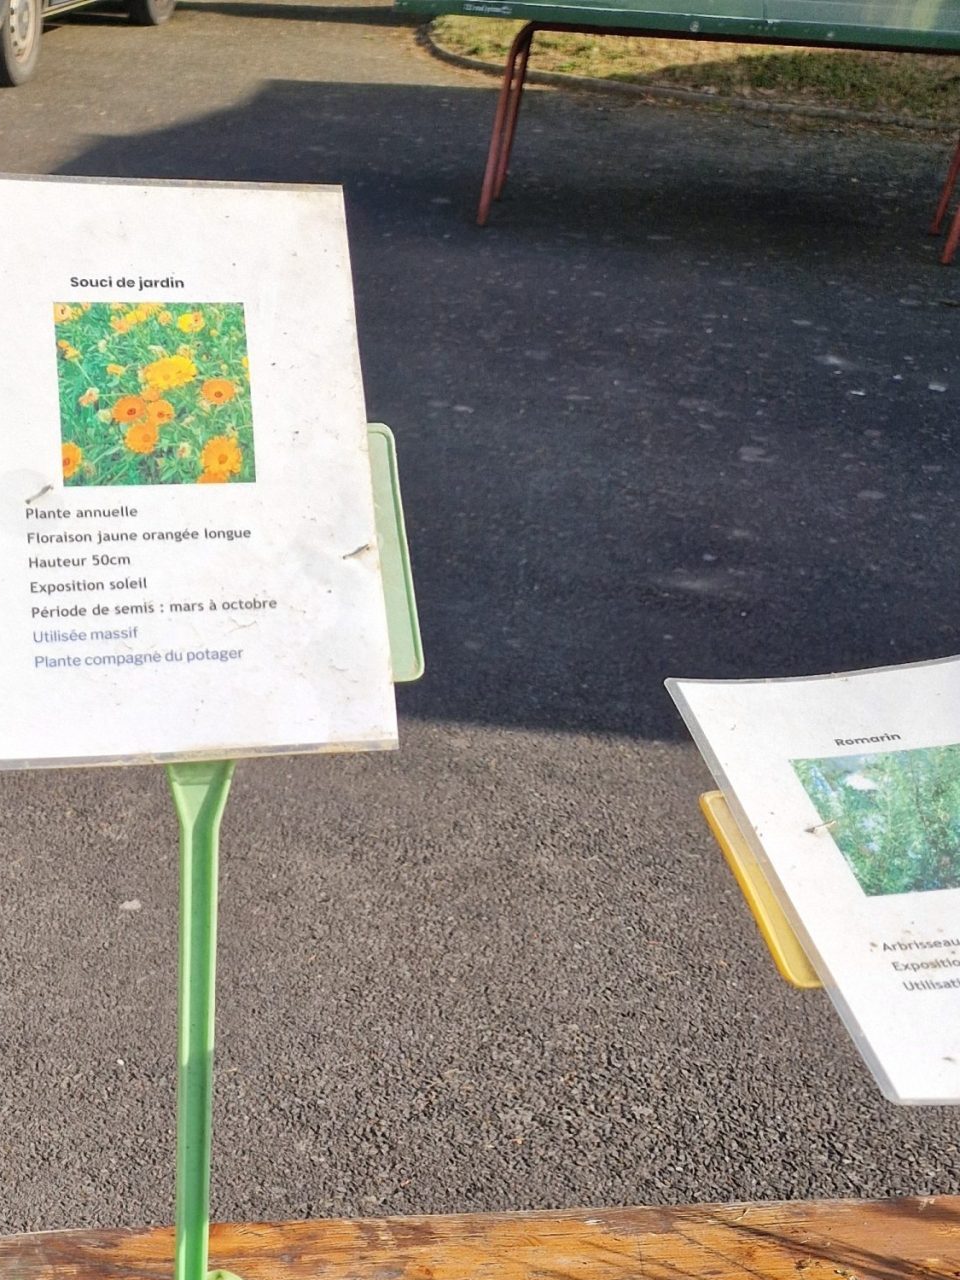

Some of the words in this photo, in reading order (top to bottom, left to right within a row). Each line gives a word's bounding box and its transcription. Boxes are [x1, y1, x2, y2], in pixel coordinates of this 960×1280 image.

[69, 276, 113, 289] Souci
[115, 277, 136, 289] de
[137, 276, 185, 292] jardin
[25, 508, 72, 520] Plante
[75, 506, 139, 519] annuelle
[26, 532, 93, 545] Floraison
[96, 530, 138, 545] jaune
[141, 528, 200, 543] orangée
[203, 528, 252, 542] longue
[28, 557, 88, 569] Hauteur
[91, 554, 131, 567] 50cm
[30, 580, 104, 595] Exposition
[108, 577, 148, 591] soleil
[30, 605, 88, 619] Période
[91, 604, 111, 617] de
[113, 601, 156, 616] semis
[169, 602, 205, 613] mars
[209, 599, 217, 611] à
[221, 597, 278, 612] octobre
[32, 630, 88, 644] Utilisée
[90, 626, 139, 641] massif
[34, 656, 82, 669] Plante
[164, 650, 184, 663] du
[186, 649, 244, 664] potager
[834, 733, 901, 746] Romarin
[882, 938, 960, 951] Arbrisseau
[891, 957, 960, 972] Expositio
